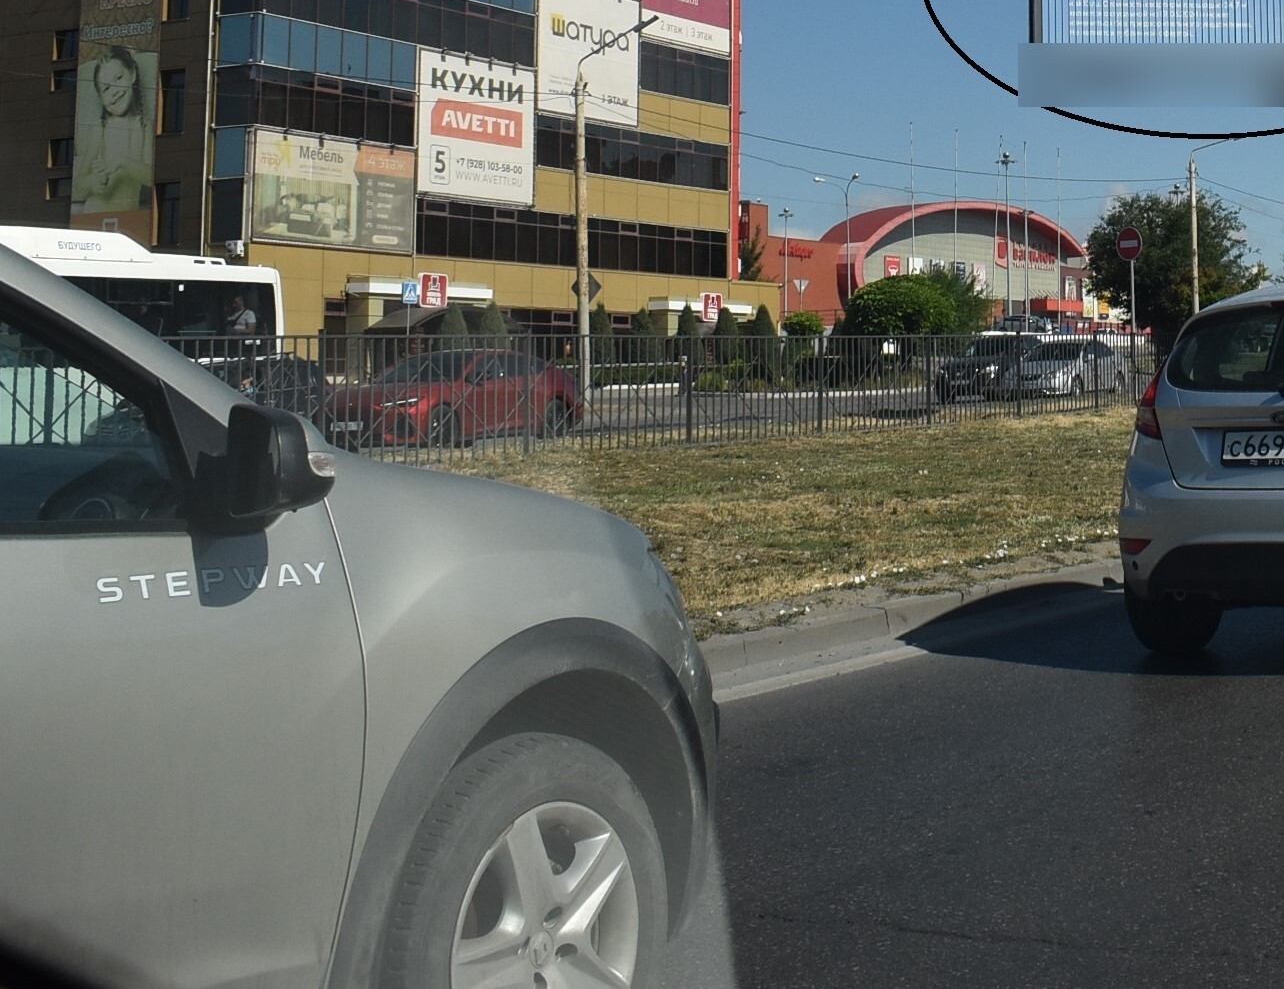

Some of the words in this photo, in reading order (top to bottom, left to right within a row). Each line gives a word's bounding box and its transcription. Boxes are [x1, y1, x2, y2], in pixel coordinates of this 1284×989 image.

[83, 17, 154, 41] Интересно?
[660, 20, 665, 30] 2
[667, 24, 683, 35] этаж
[691, 27, 696, 38] 3
[697, 31, 713, 41] этаж
[431, 67, 524, 104] КУХНИ
[441, 109, 515, 138] AVETTI
[300, 145, 344, 164] Мебель
[368, 154, 375, 167] 4
[378, 158, 406, 171] этаж
[434, 150, 446, 174] 5
[456, 158, 465, 166] +7
[467, 159, 486, 171] (928)
[487, 161, 523, 175] 103-58-00
[456, 171, 523, 188] WWW.AVETTI.RU
[58, 241, 102, 251] БУДУЩЕГО
[96, 561, 326, 603] STEPWAY
